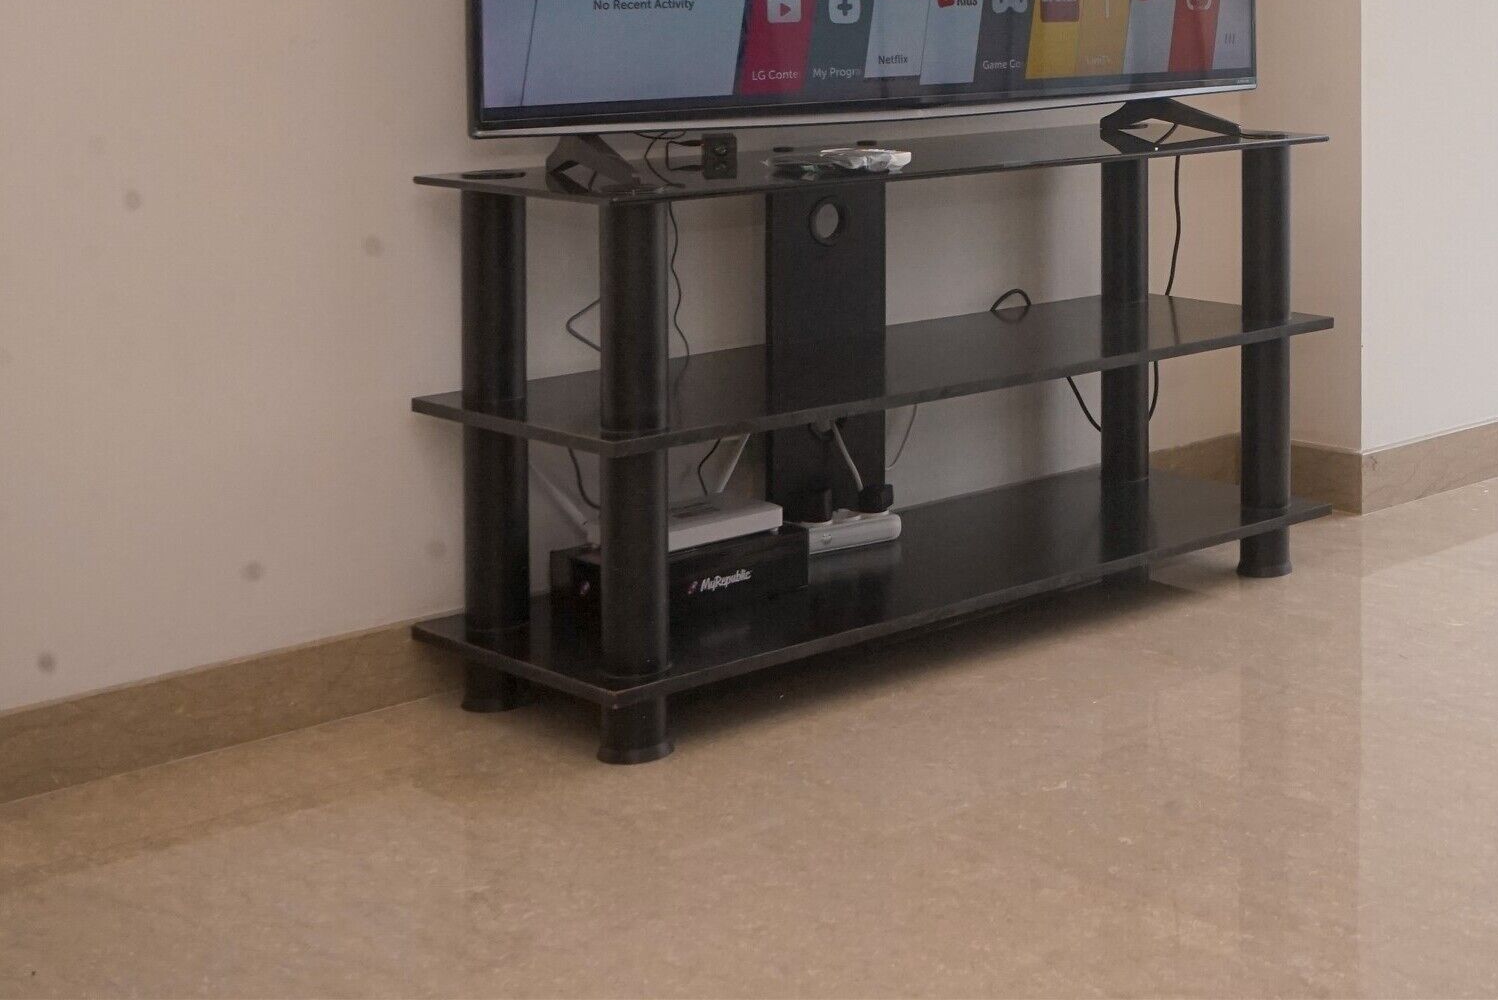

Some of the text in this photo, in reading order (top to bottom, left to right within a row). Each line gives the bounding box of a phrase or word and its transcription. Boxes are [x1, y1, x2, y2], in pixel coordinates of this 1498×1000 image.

[593, 0, 610, 10] No
[613, 0, 651, 10] Recent
[878, 55, 908, 65] Netflix
[982, 60, 1007, 70] Game
[752, 69, 799, 81] LG Conte
[812, 68, 828, 80] My
[700, 569, 752, 592] MyRepublic
